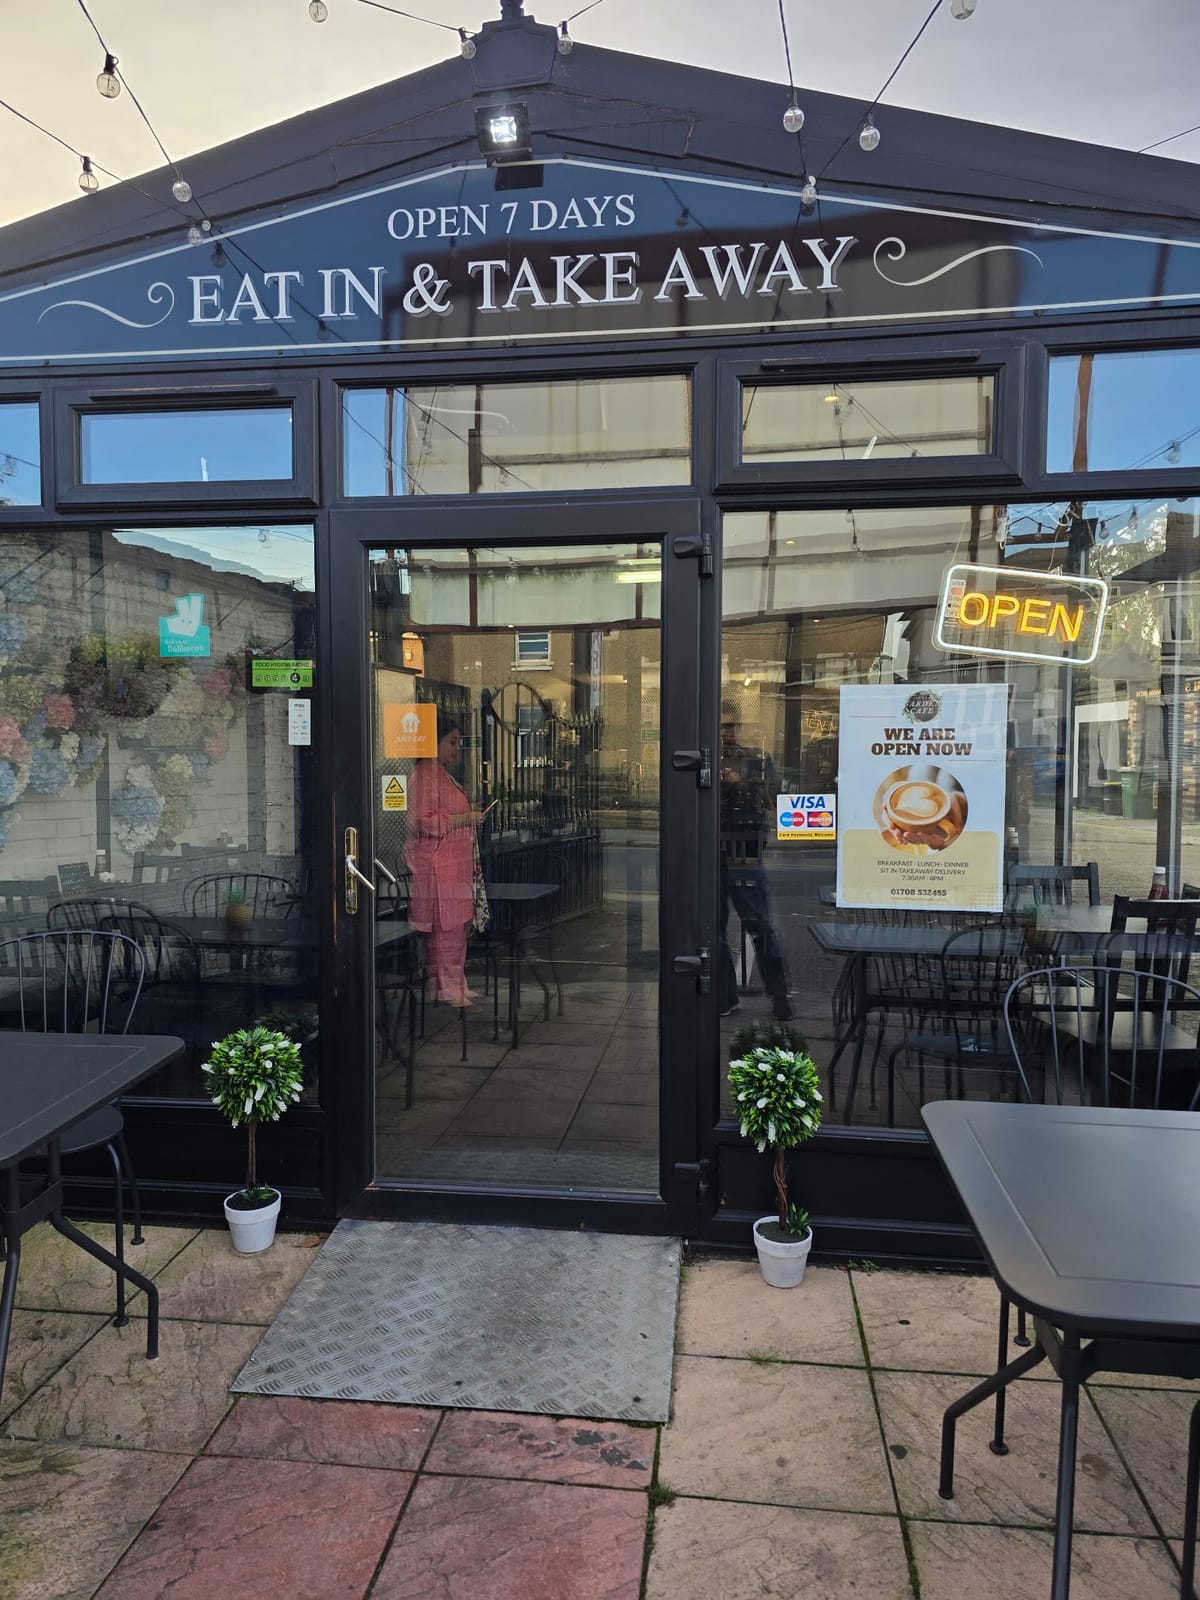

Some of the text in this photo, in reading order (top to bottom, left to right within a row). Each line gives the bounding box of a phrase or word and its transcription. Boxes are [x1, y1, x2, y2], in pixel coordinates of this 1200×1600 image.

[387, 194, 635, 240] OPEN 7 DAYS
[187, 235, 857, 324] EAT IN & TAKE AWAY
[959, 592, 1084, 642] OPEN
[291, 674, 298, 682] 4
[884, 728, 955, 740] WE ARE
[871, 742, 972, 756] OPEN NOW
[788, 796, 826, 809] VISA
[890, 888, 916, 896] 01708
